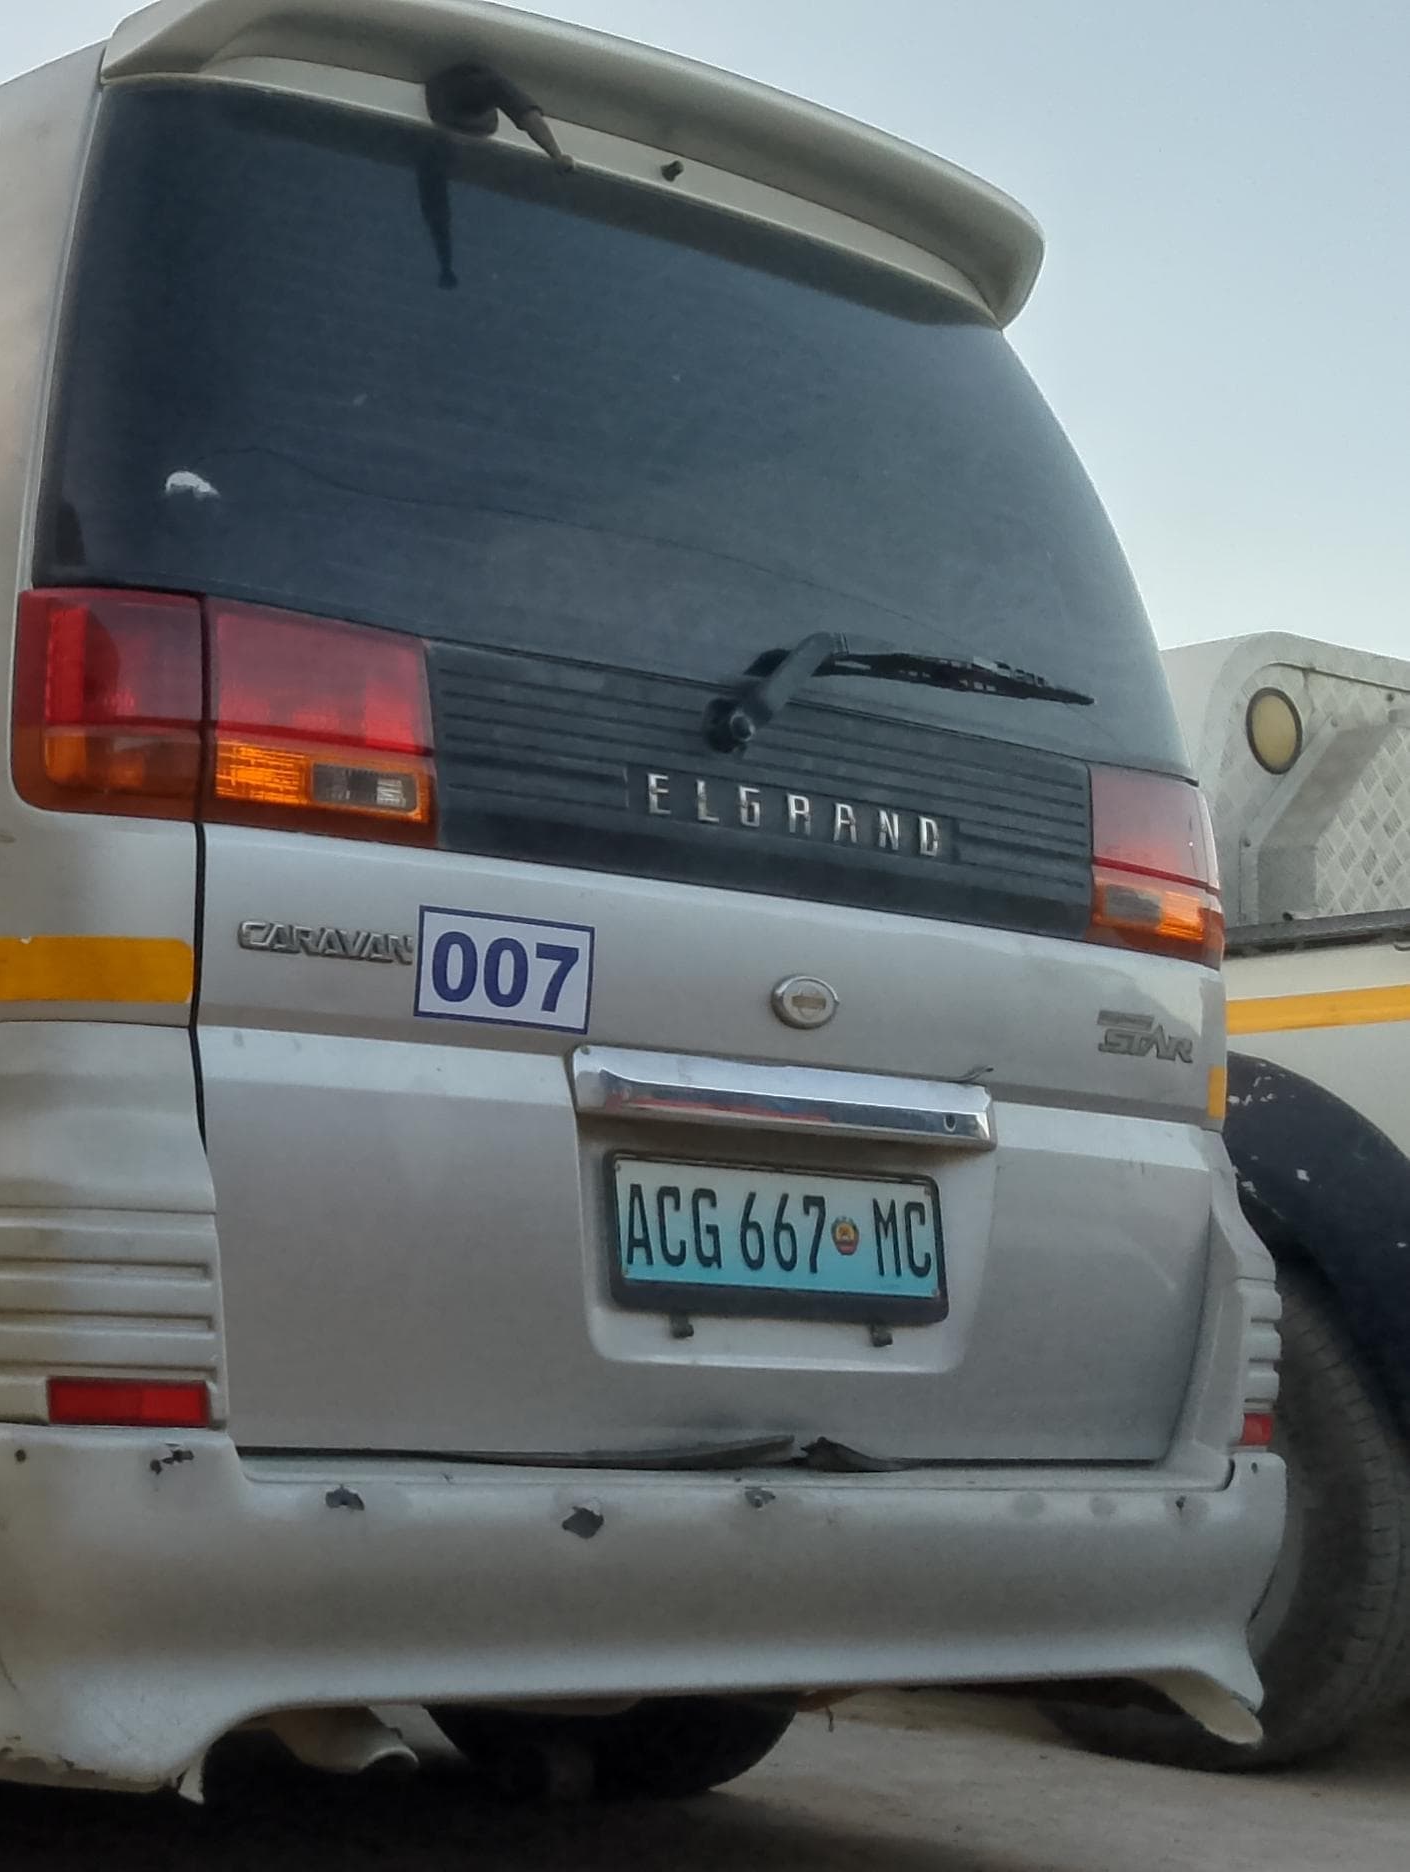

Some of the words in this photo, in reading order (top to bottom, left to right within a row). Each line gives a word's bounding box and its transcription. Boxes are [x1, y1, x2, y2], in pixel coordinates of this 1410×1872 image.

[646, 772, 940, 858] ELGRAND
[238, 920, 413, 966] CARAVAN
[431, 930, 580, 1013] 007
[1098, 1024, 1193, 1064] STAR
[626, 1183, 723, 1269] ACG
[739, 1191, 827, 1275] 667
[871, 1197, 932, 1278] MC
